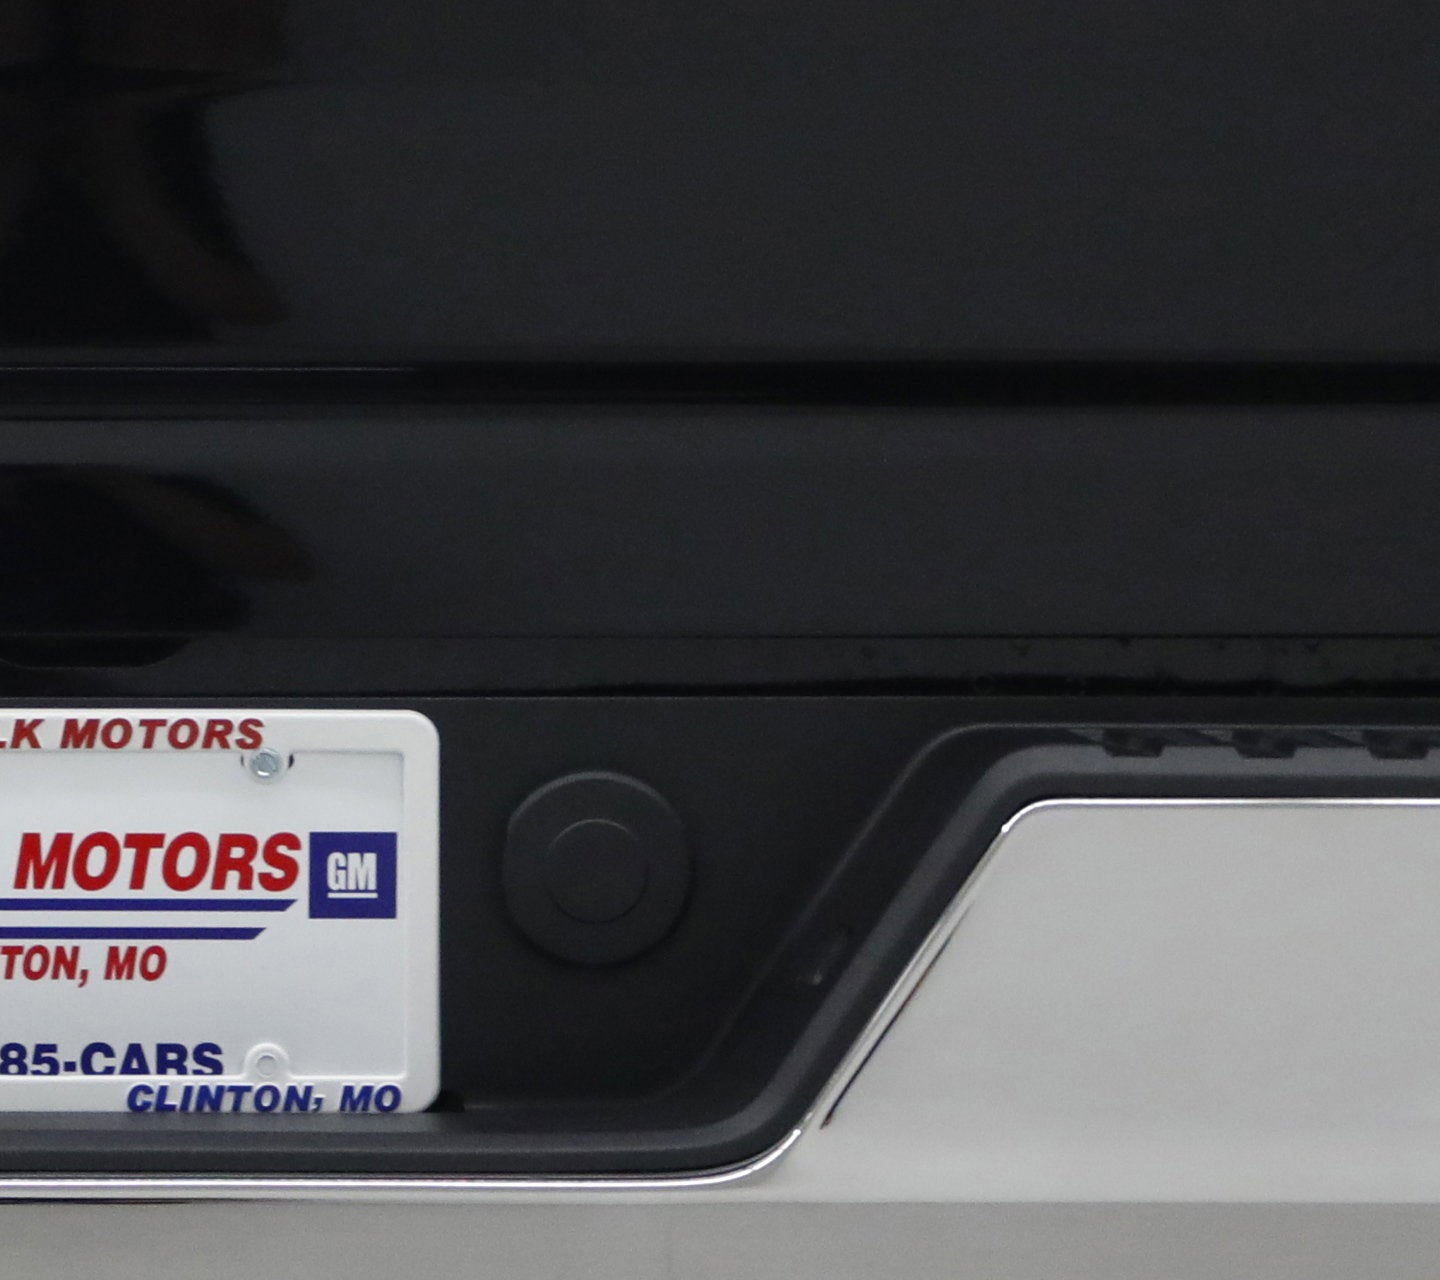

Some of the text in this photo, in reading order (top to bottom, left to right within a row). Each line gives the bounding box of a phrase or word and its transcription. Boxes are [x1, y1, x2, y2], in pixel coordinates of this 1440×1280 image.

[59, 718, 265, 750] MOTORS
[13, 831, 302, 892] MOTORS
[326, 851, 378, 892] GM
[104, 945, 167, 982] MO
[127, 1084, 402, 1113] CLINTON, MO
